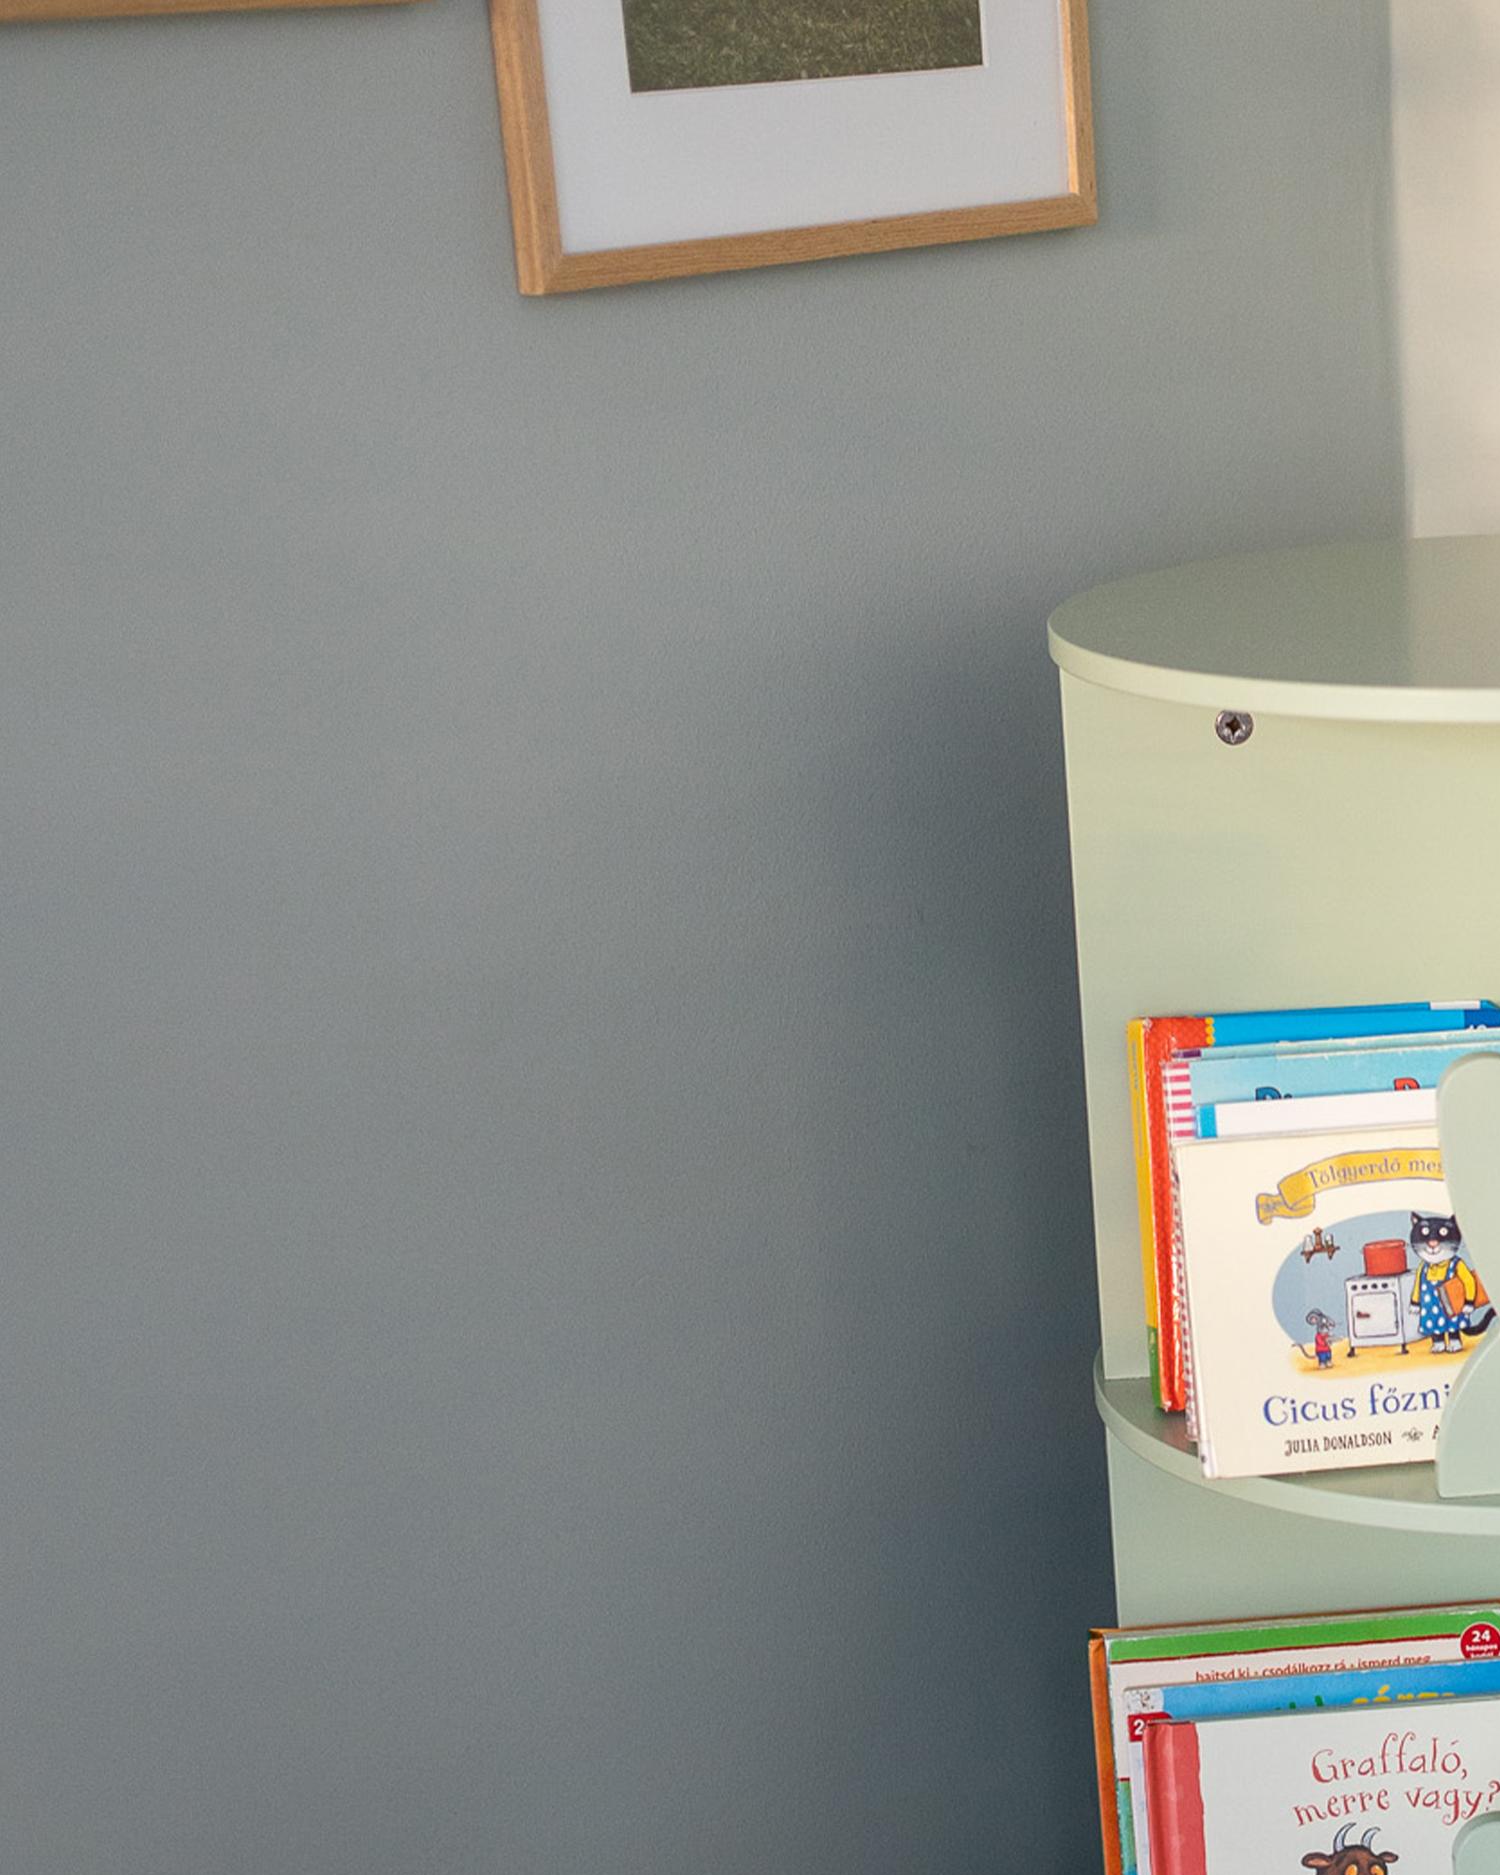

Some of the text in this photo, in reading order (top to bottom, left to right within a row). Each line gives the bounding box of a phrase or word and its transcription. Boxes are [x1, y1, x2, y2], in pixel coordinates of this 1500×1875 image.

[1306, 1158, 1400, 1188] Tölgyerdő
[1263, 1396, 1357, 1426] Cicus
[1284, 1431, 1392, 1457] JULIA DONALDSON
[1472, 1630, 1490, 1642] 24
[1262, 1661, 1331, 1677] csodálkozz
[1335, 1659, 1346, 1671] rá
[1358, 1655, 1401, 1669] ismerd
[1311, 1731, 1468, 1783] Graffaló,
[1293, 1789, 1390, 1827] merre
